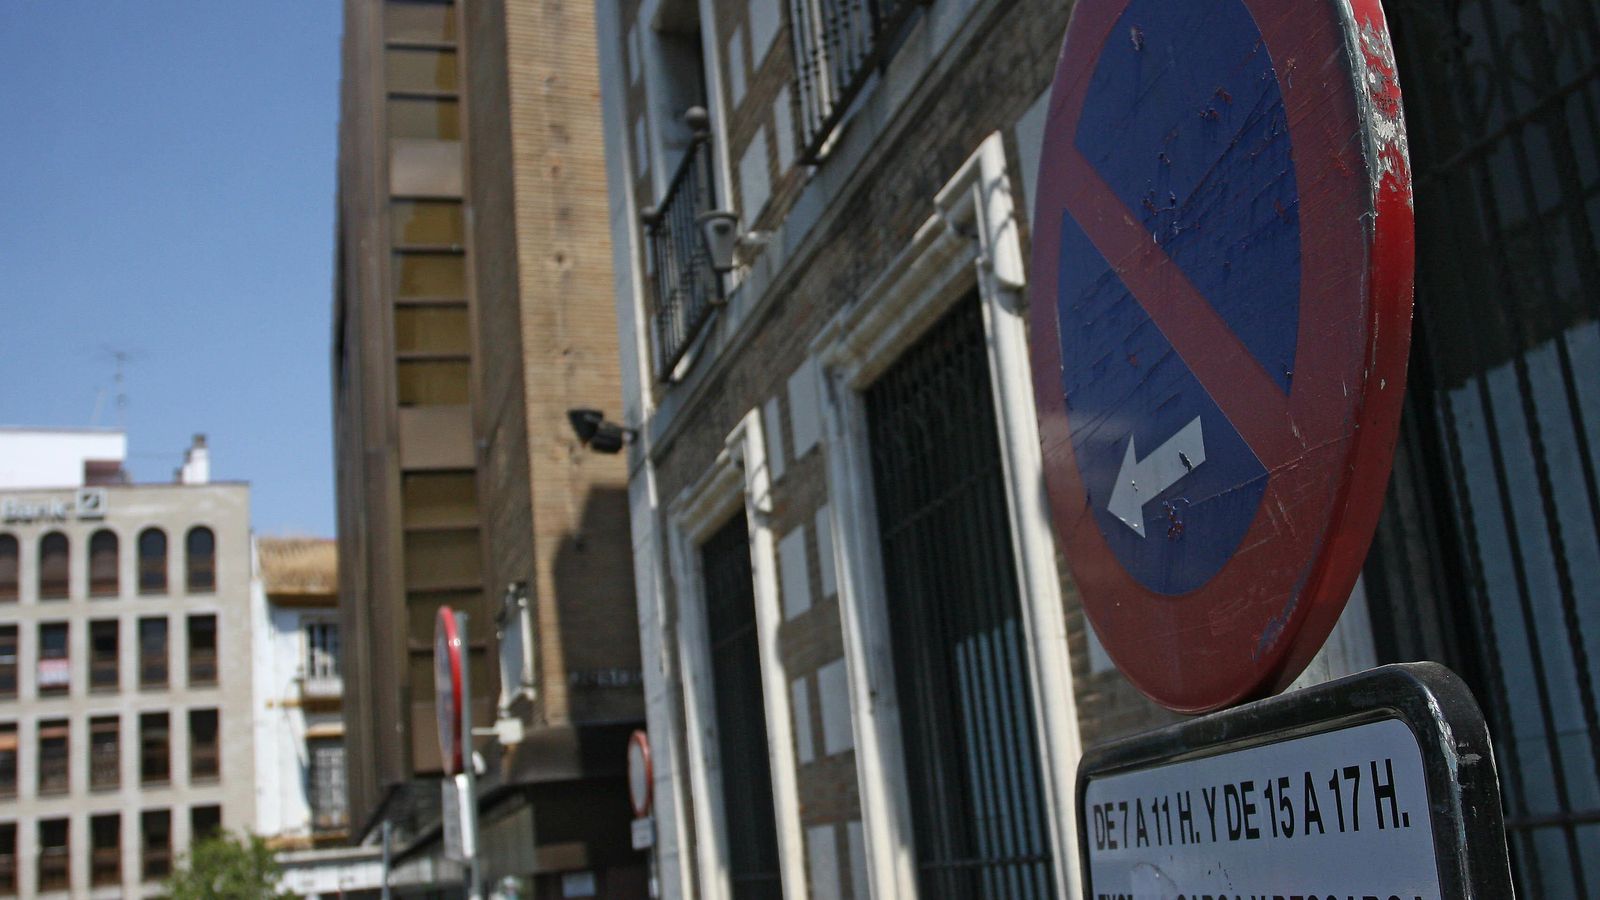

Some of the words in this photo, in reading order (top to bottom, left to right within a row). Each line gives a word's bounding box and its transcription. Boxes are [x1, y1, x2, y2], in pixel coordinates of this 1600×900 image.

[1093, 803, 1118, 850] DE
[1118, 801, 1129, 849] 7
[1136, 797, 1150, 847] A
[1151, 795, 1173, 846] 11
[1176, 791, 1201, 844] H.
[1202, 786, 1217, 842] Y
[1224, 780, 1261, 841] DE
[1264, 776, 1295, 838] 15
[1304, 772, 1326, 835] A
[1329, 765, 1361, 832] 17
[1370, 758, 1411, 829] H.
